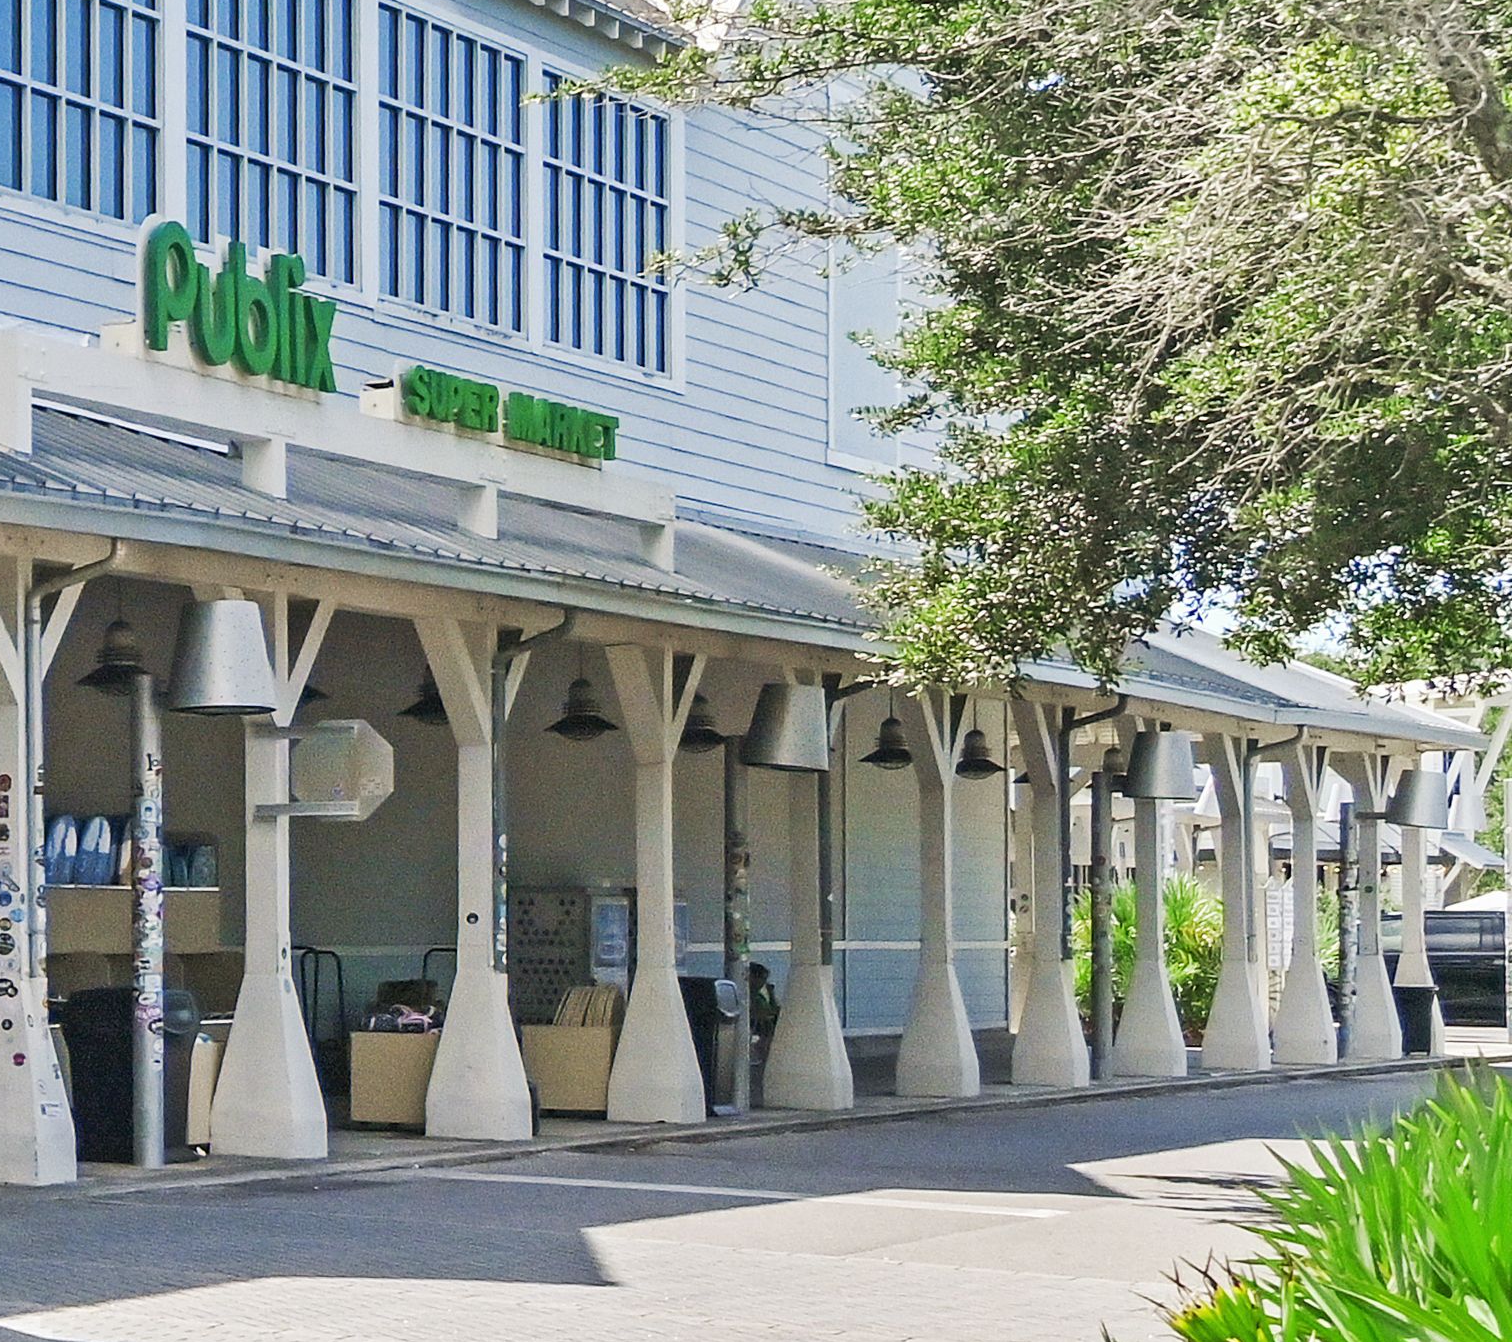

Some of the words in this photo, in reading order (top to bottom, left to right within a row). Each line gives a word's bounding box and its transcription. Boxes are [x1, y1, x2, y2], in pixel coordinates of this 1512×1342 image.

[143, 221, 337, 394] Publix
[408, 364, 500, 433] SUPER
[509, 392, 620, 461] MARKET
